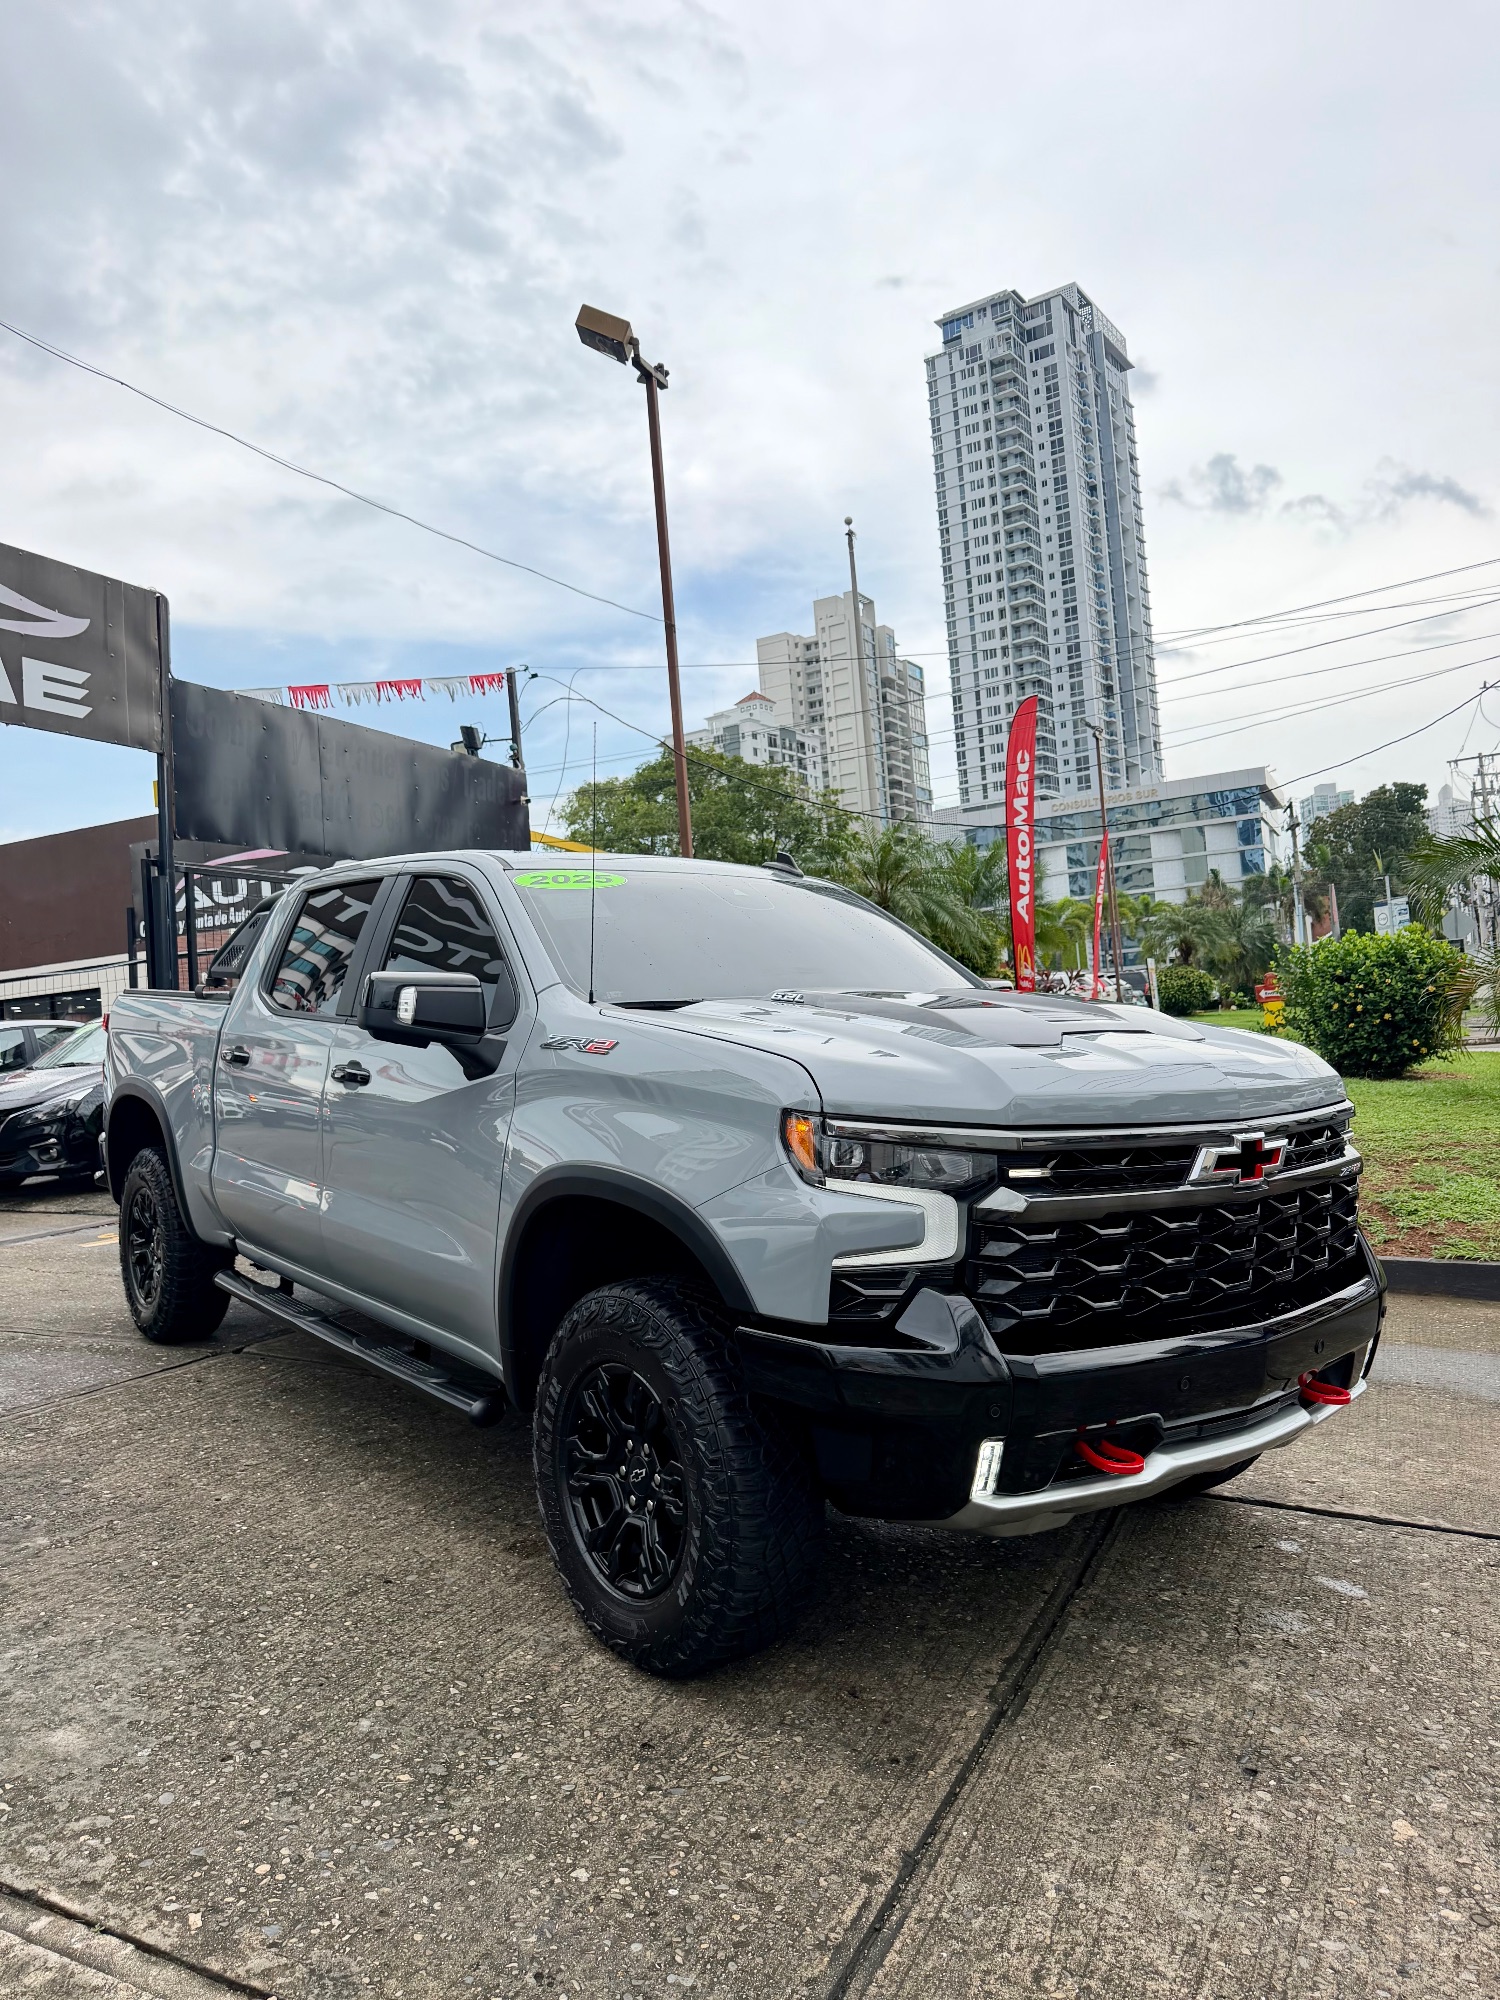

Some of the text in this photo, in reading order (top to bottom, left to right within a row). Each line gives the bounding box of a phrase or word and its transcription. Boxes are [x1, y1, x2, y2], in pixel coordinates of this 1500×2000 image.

[1135, 788, 1159, 800] SUR
[1013, 749, 1031, 924] AutoMac
[529, 874, 613, 885] 2025
[214, 909, 228, 926] de
[540, 1034, 620, 1055] ZR2
